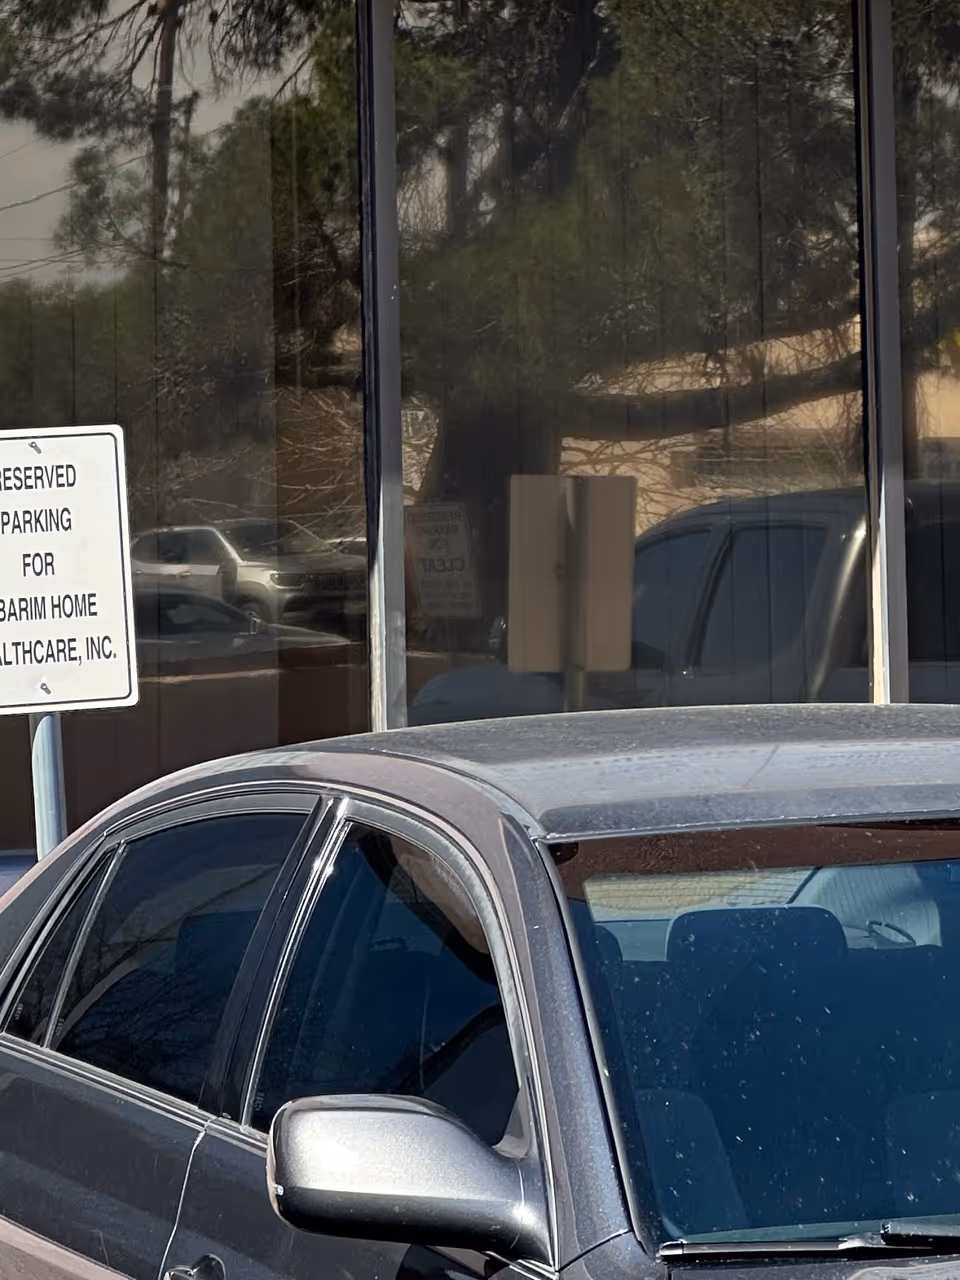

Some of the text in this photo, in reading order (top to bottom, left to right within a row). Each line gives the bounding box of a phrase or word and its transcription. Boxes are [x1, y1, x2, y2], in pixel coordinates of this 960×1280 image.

[0, 464, 76, 491] ESERVED
[1, 507, 72, 534] PARKING
[22, 552, 55, 577] FOR
[51, 593, 98, 619] HOME
[0, 635, 117, 666] LTHCARE, INC.
